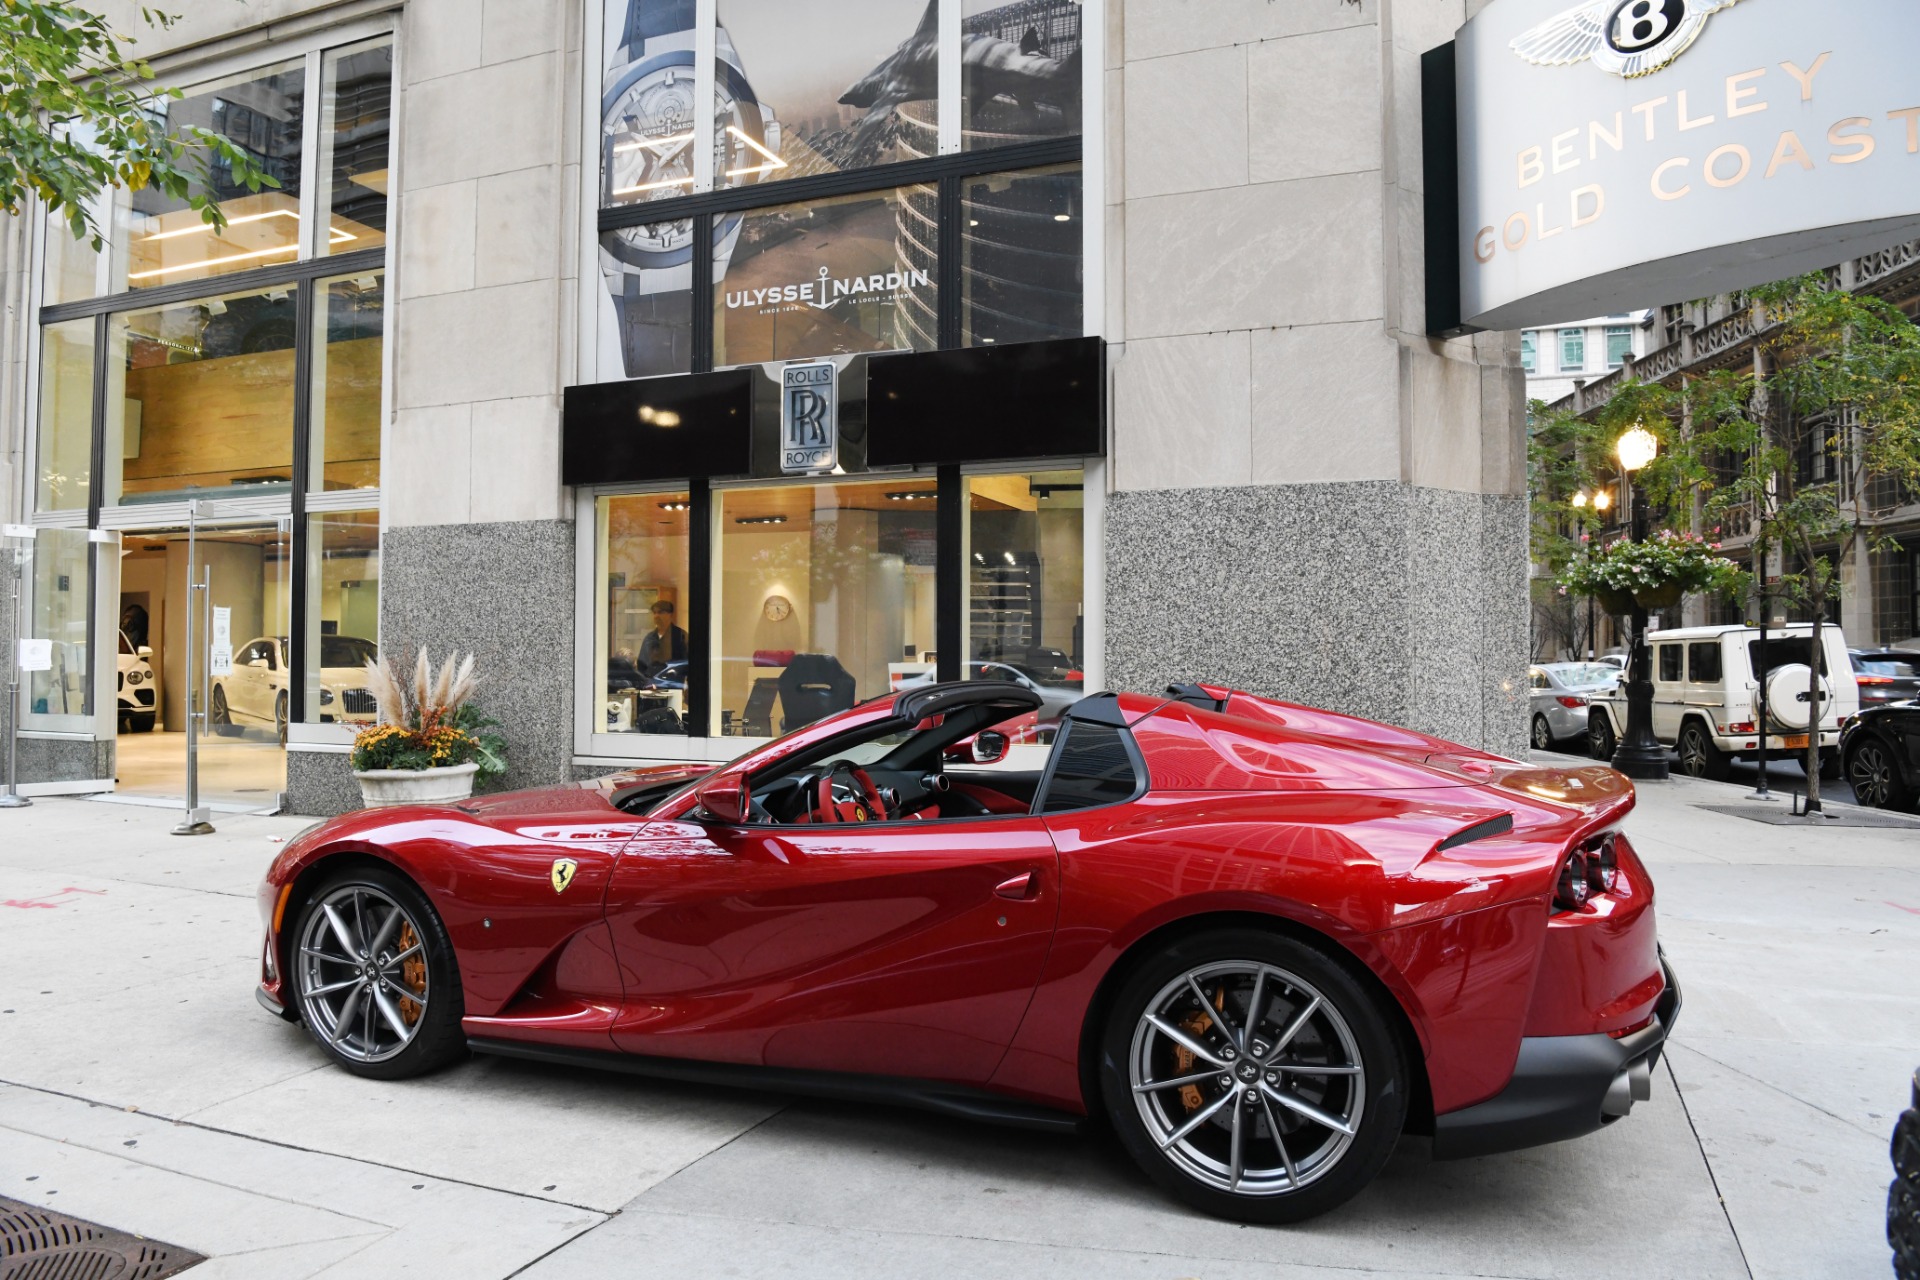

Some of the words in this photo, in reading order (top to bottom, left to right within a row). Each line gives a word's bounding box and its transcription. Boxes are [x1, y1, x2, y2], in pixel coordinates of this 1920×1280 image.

[640, 126, 666, 136] ULYSSE
[672, 121, 694, 131] NARDI
[1517, 51, 1833, 190] BENTLEY
[1473, 183, 1605, 265] GOLD
[1650, 106, 1920, 201] COAST
[726, 282, 814, 309] ULYSSE
[833, 269, 928, 297] NARDIN
[787, 368, 829, 384] ROLLS
